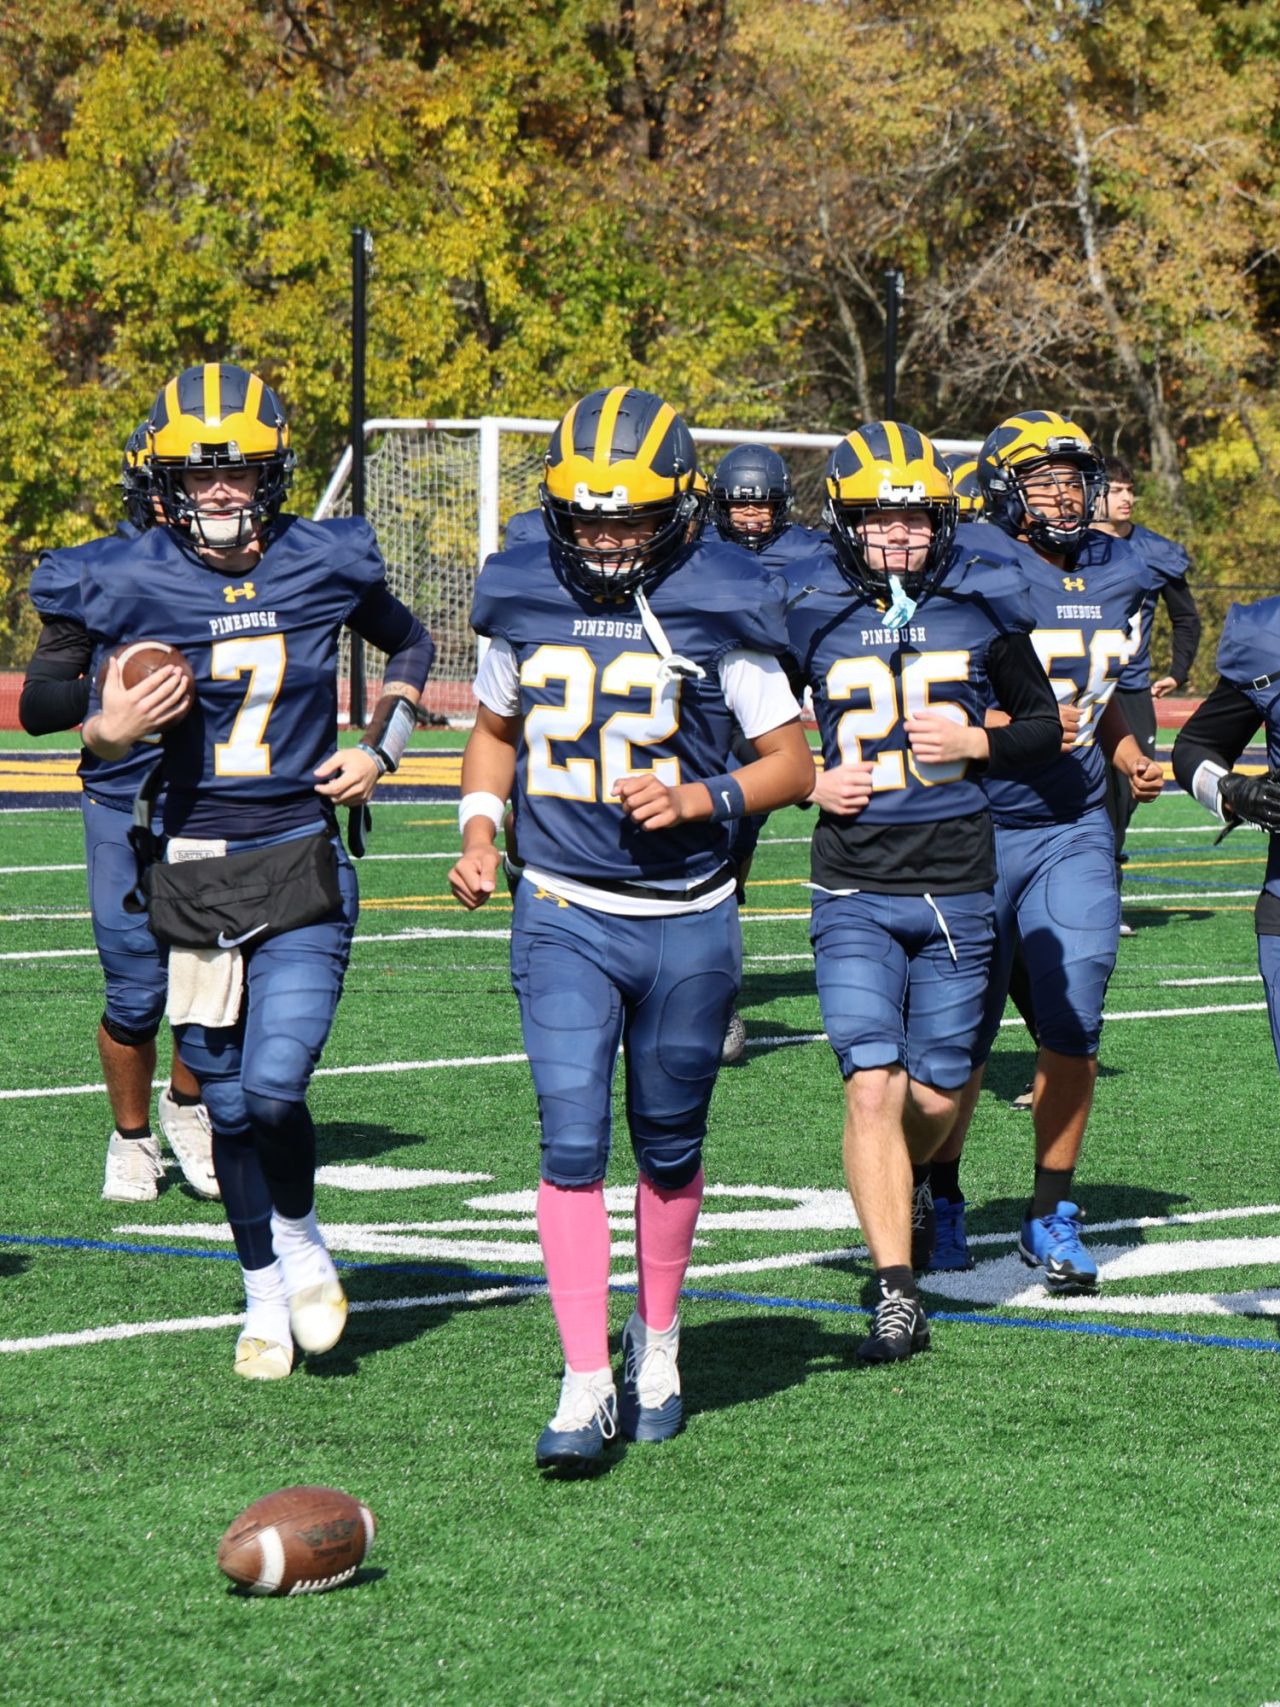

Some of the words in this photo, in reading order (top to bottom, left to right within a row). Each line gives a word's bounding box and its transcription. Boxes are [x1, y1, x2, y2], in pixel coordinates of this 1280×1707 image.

[209, 612, 277, 636] PINEBUSH
[1056, 605, 1103, 620] PINEBUSH
[572, 620, 643, 640] PINEBUSH
[861, 627, 926, 645] PINEBUSH
[211, 633, 288, 777] 7
[520, 644, 682, 804] 22
[826, 650, 971, 792] 25
